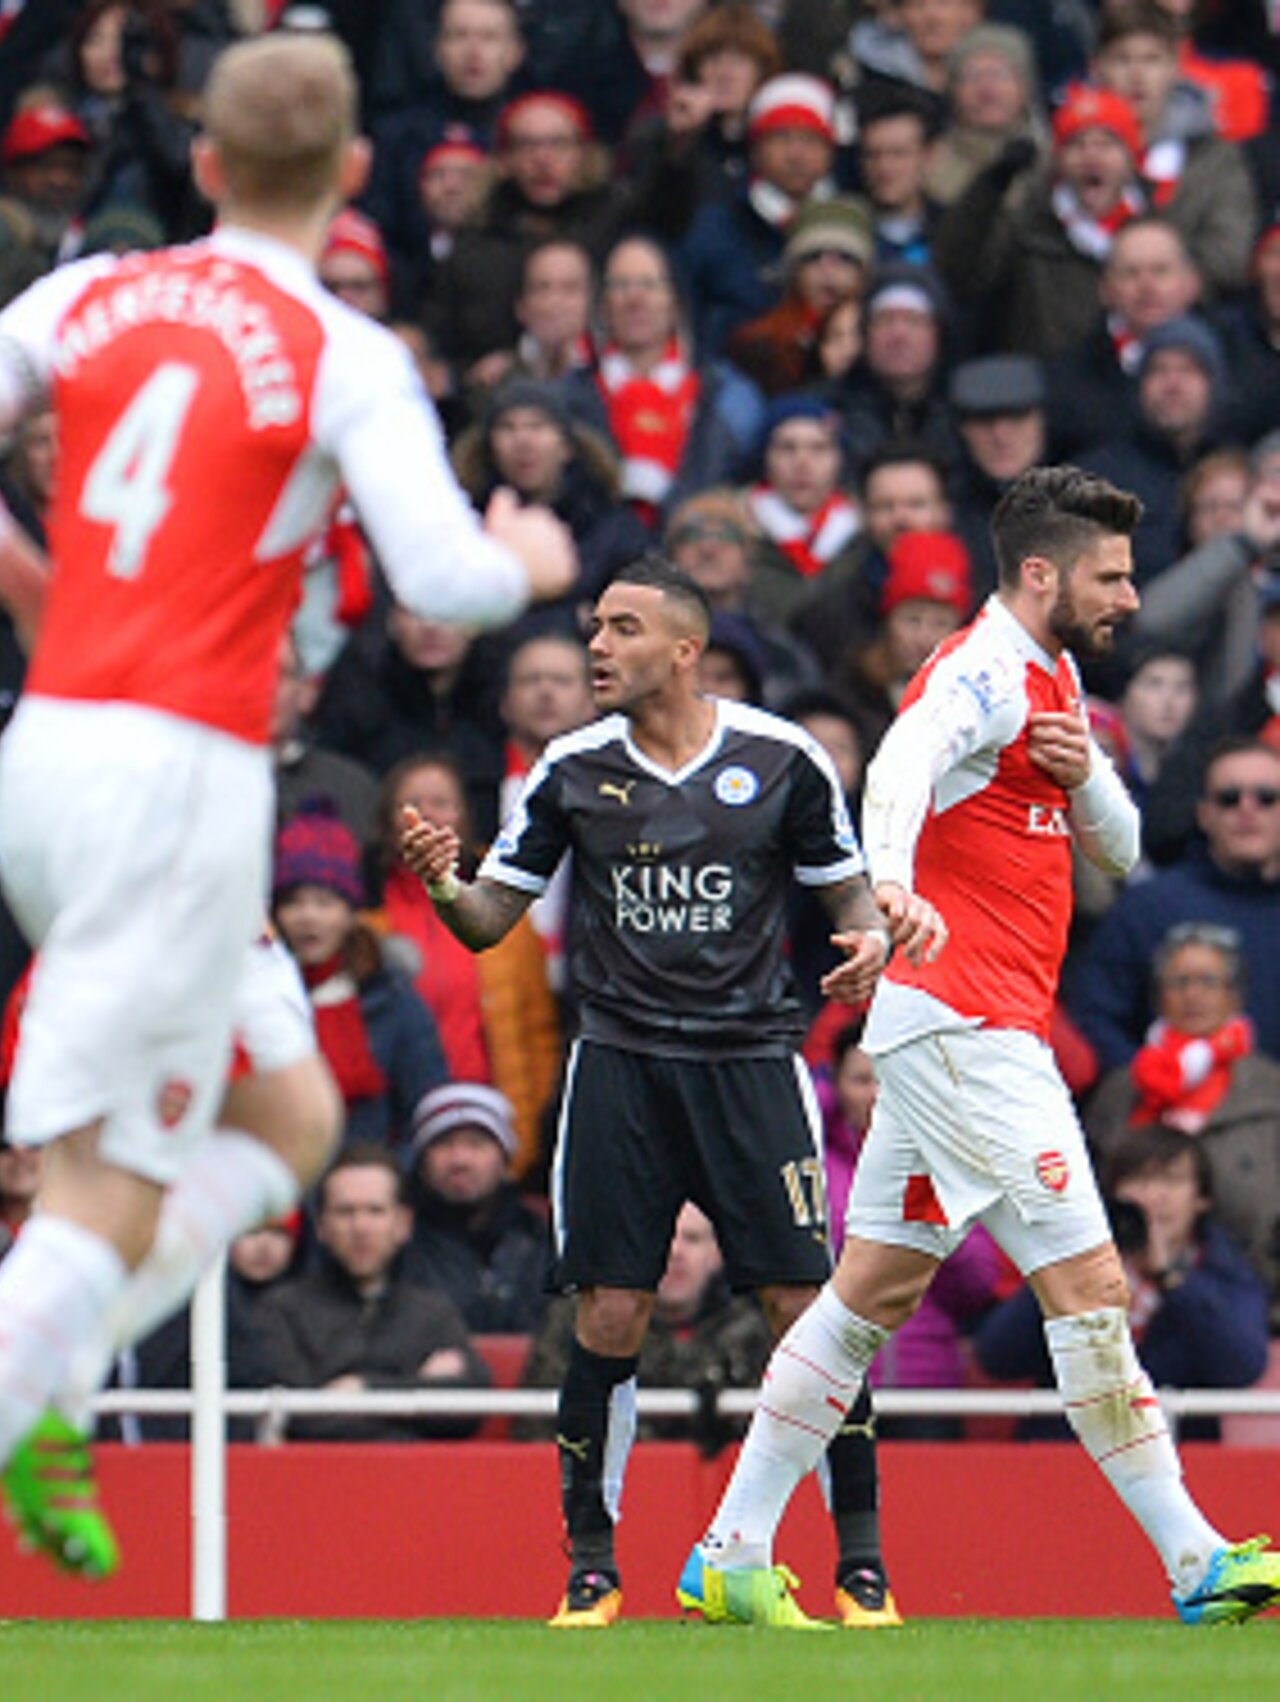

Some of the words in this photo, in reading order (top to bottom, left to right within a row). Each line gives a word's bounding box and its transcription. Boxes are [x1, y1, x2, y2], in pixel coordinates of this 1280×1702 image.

[79, 361, 200, 582] 4
[612, 865, 732, 901] KING
[616, 904, 732, 932] POWER
[781, 1158, 825, 1226] 17
